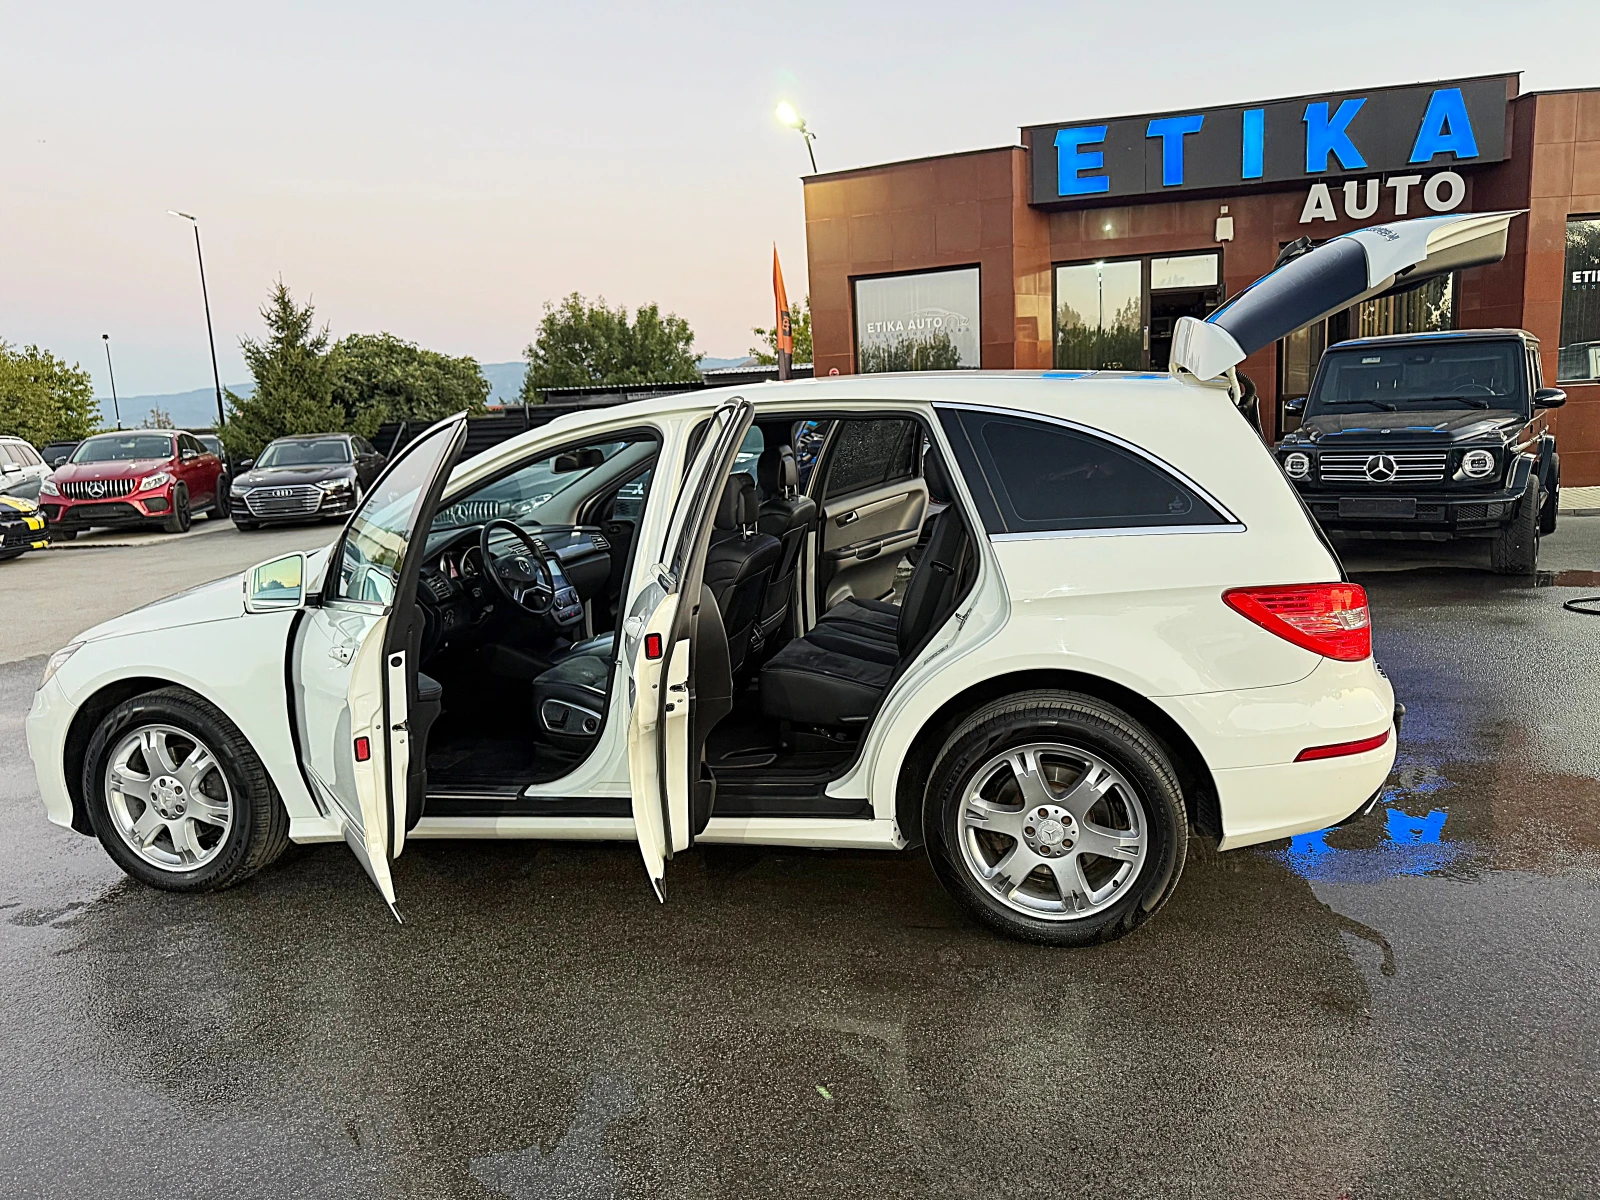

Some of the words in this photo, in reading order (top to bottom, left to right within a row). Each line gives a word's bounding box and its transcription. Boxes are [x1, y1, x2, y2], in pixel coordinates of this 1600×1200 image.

[1053, 87, 1479, 196] ETIKA
[1299, 171, 1466, 224] AUTO
[867, 319, 905, 333] ETIKA
[908, 317, 943, 330] AUTO
